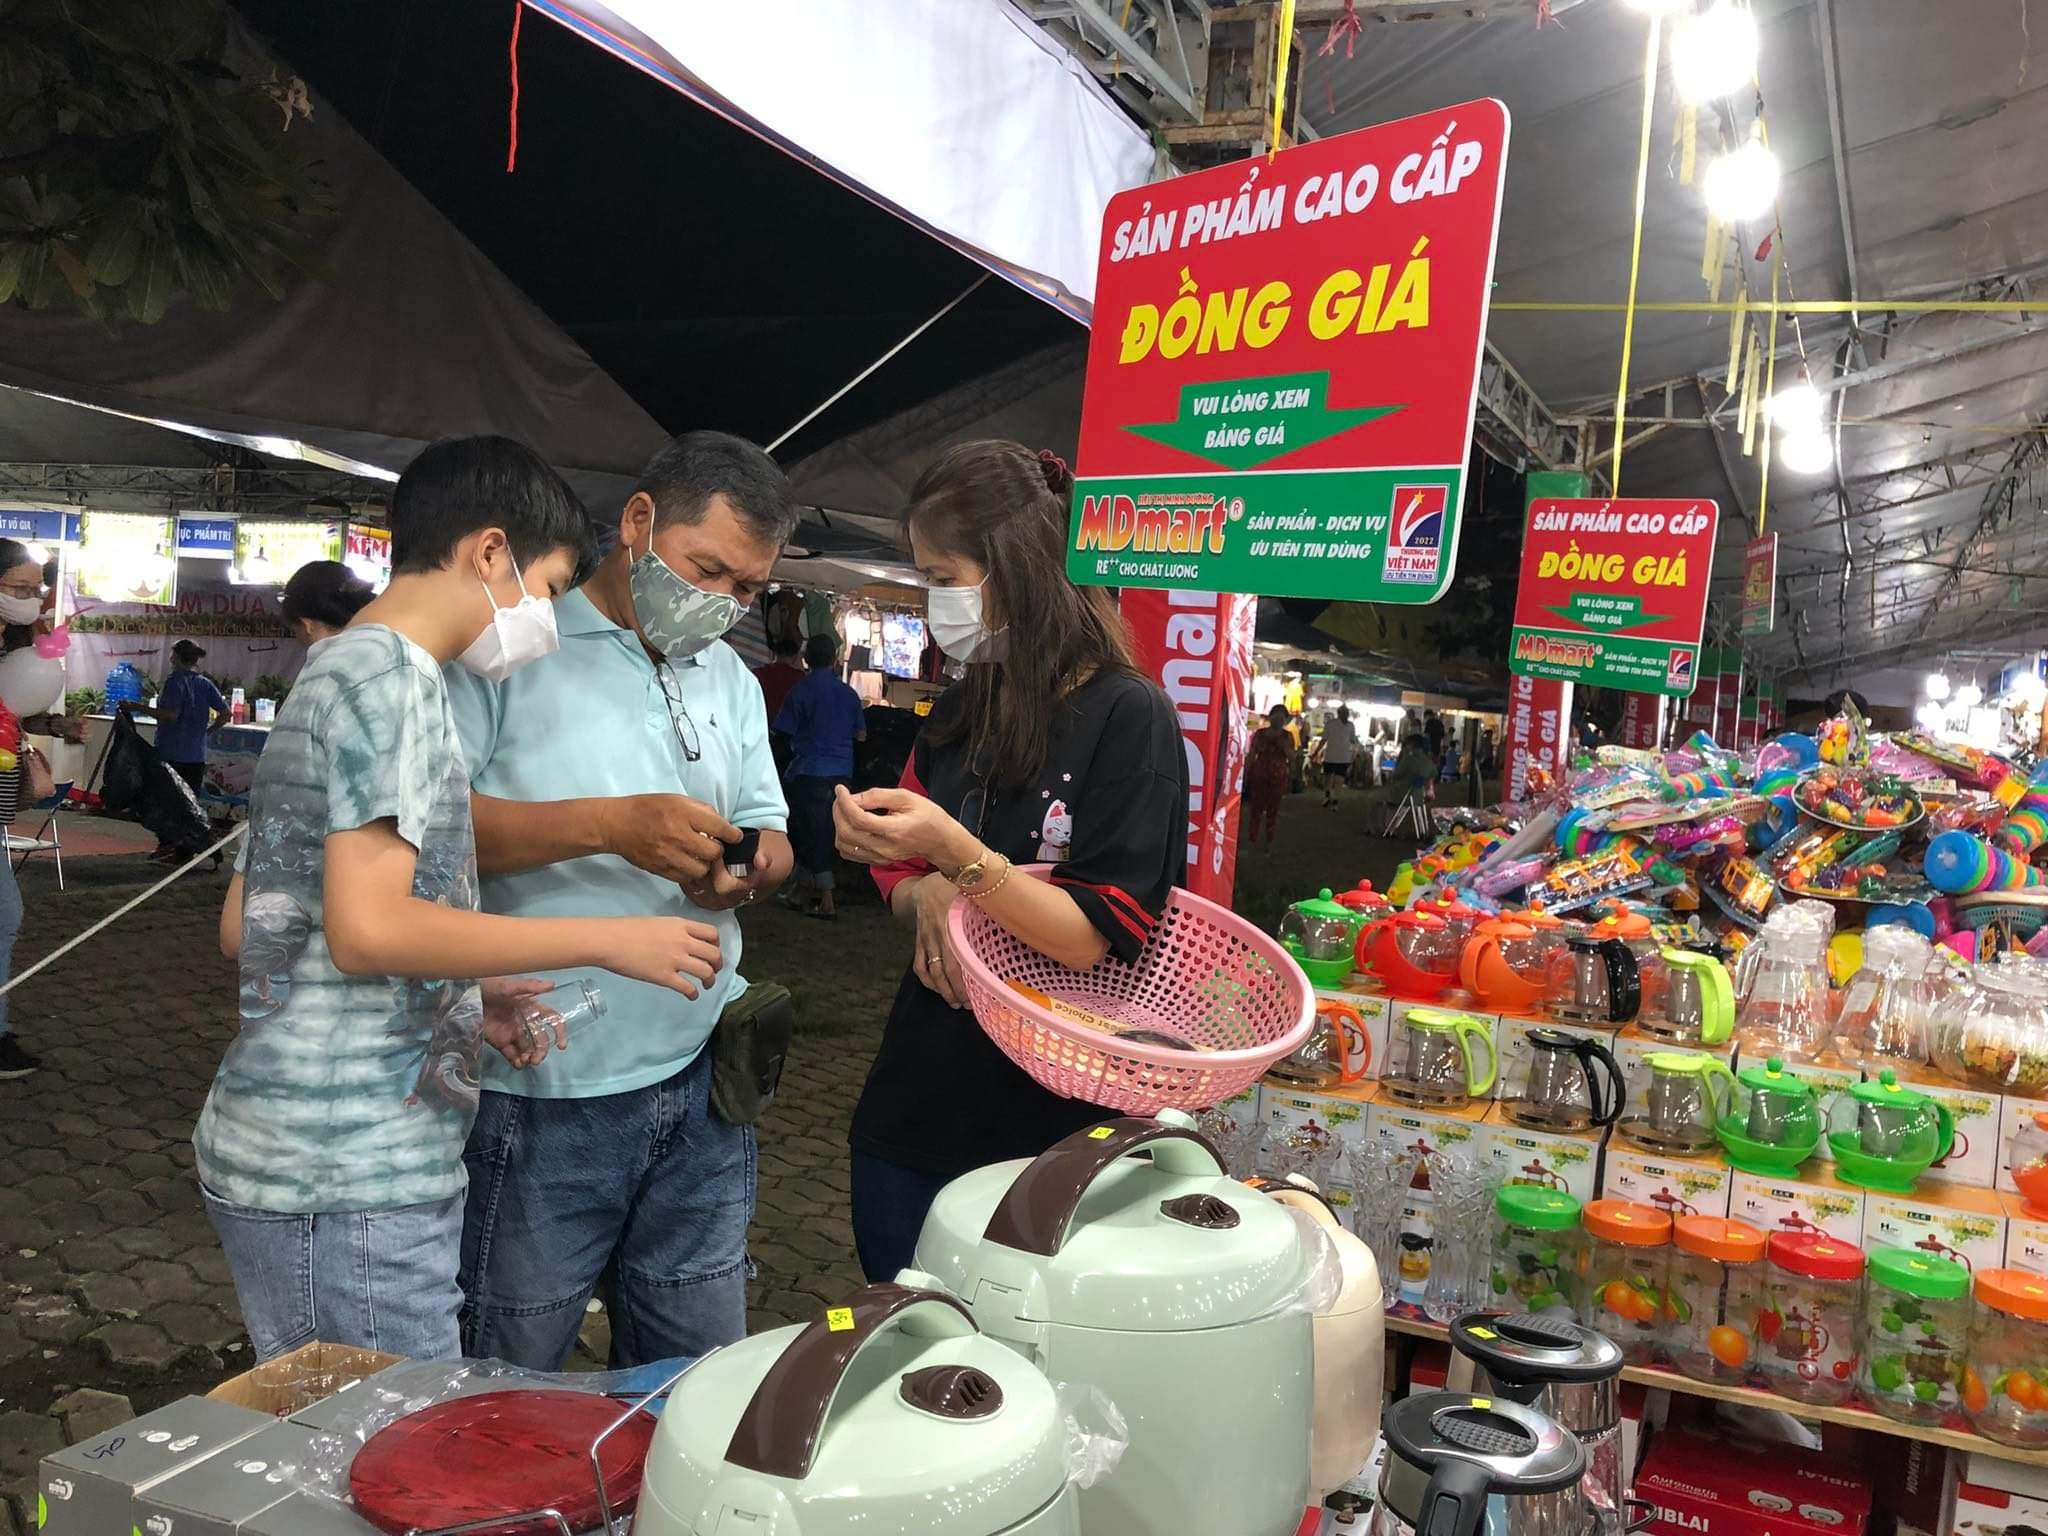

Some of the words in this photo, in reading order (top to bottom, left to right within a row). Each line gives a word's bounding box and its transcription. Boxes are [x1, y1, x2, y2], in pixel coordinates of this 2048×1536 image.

[1110, 201, 1177, 262] SẢN
[1180, 166, 1287, 248] PHẨM
[1293, 164, 1379, 222] CAO
[1389, 120, 1482, 203] CẤP
[1118, 265, 1291, 365] ĐỒNG
[1308, 235, 1430, 341] GIÁ
[1193, 394, 1220, 416] VUI
[1223, 387, 1270, 414] LÒNG
[1271, 388, 1311, 409] XEM
[1205, 422, 1252, 449] BẢNG
[1255, 421, 1285, 445] GIÁ
[1076, 494, 1228, 554] MDmart
[1247, 511, 1275, 530] SẢN
[1276, 508, 1316, 531] PHẨM
[1326, 516, 1362, 535] DỊCH
[1365, 516, 1387, 535] VỤ
[1533, 506, 1568, 532] SẢN
[1570, 502, 1622, 533] PHẨM
[1626, 516, 1665, 534] CAO
[1669, 505, 1709, 536] CẤP
[1250, 539, 1269, 556] ƯU
[1272, 539, 1301, 557] TIÊN
[1303, 544, 1326, 558] TIN
[1327, 540, 1371, 559] DÙNG
[1388, 554, 1410, 571] VIỆT
[1412, 559, 1436, 570] NAM
[1538, 539, 1625, 584] ĐỒNG
[1632, 549, 1687, 587] GIÁ
[1120, 562, 1138, 577] CHO
[1576, 598, 1590, 608] VUI
[1615, 601, 1635, 612] XEM
[1515, 634, 1596, 668] MDmart
[1538, 710, 1557, 743] GIÁ
[1054, 1002, 1094, 1024] Choice
